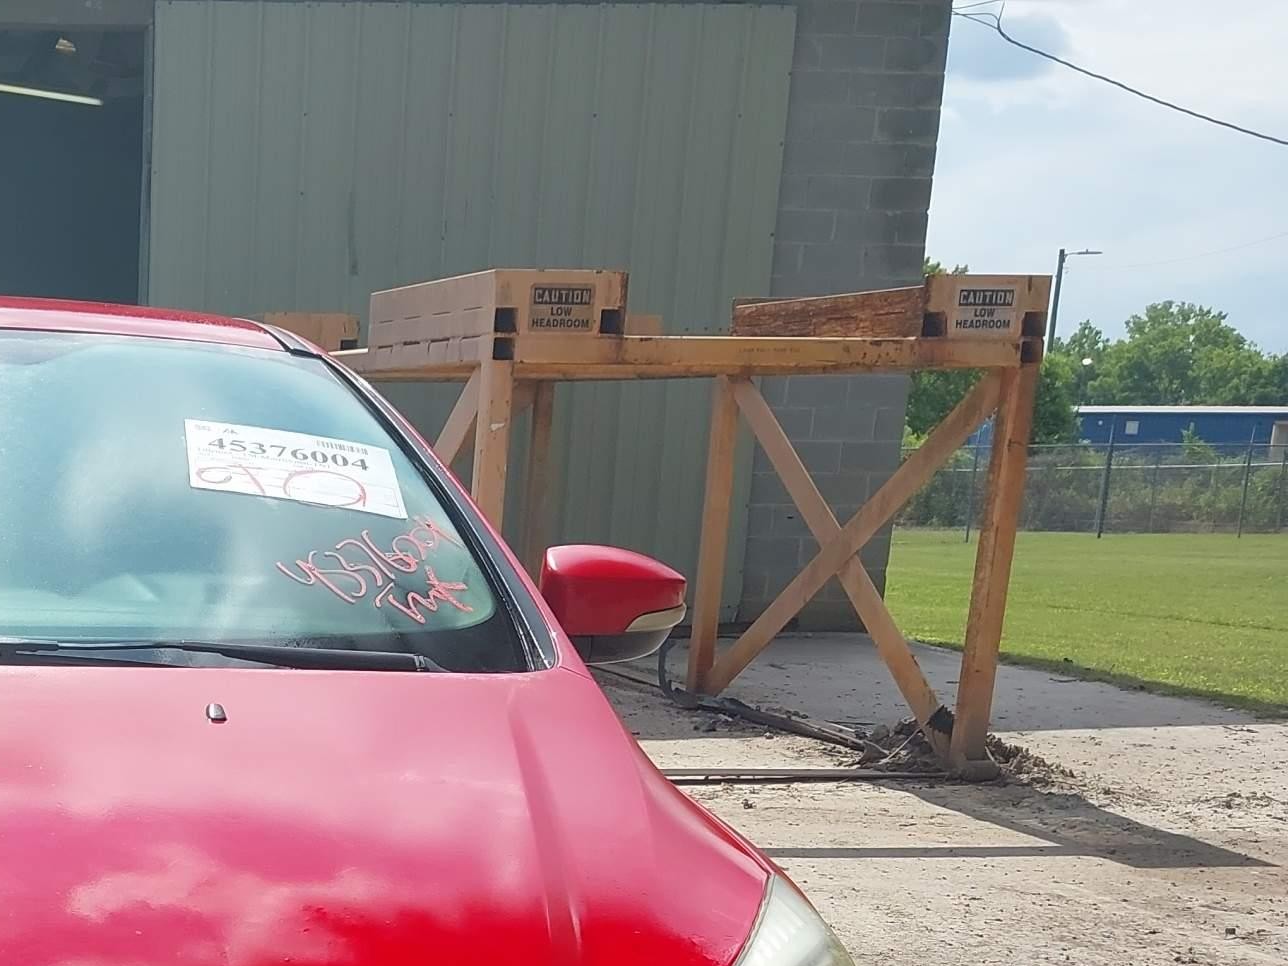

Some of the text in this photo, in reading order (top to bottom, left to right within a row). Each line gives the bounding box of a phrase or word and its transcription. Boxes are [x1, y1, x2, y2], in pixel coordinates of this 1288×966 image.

[535, 289, 590, 303] CAUTION
[960, 291, 1013, 304] CAUTION
[550, 306, 572, 316] LOW
[974, 308, 995, 317] LOW
[532, 318, 589, 328] HEADROOM
[955, 319, 1010, 329] HEADROOM
[208, 438, 369, 471] 45376004
